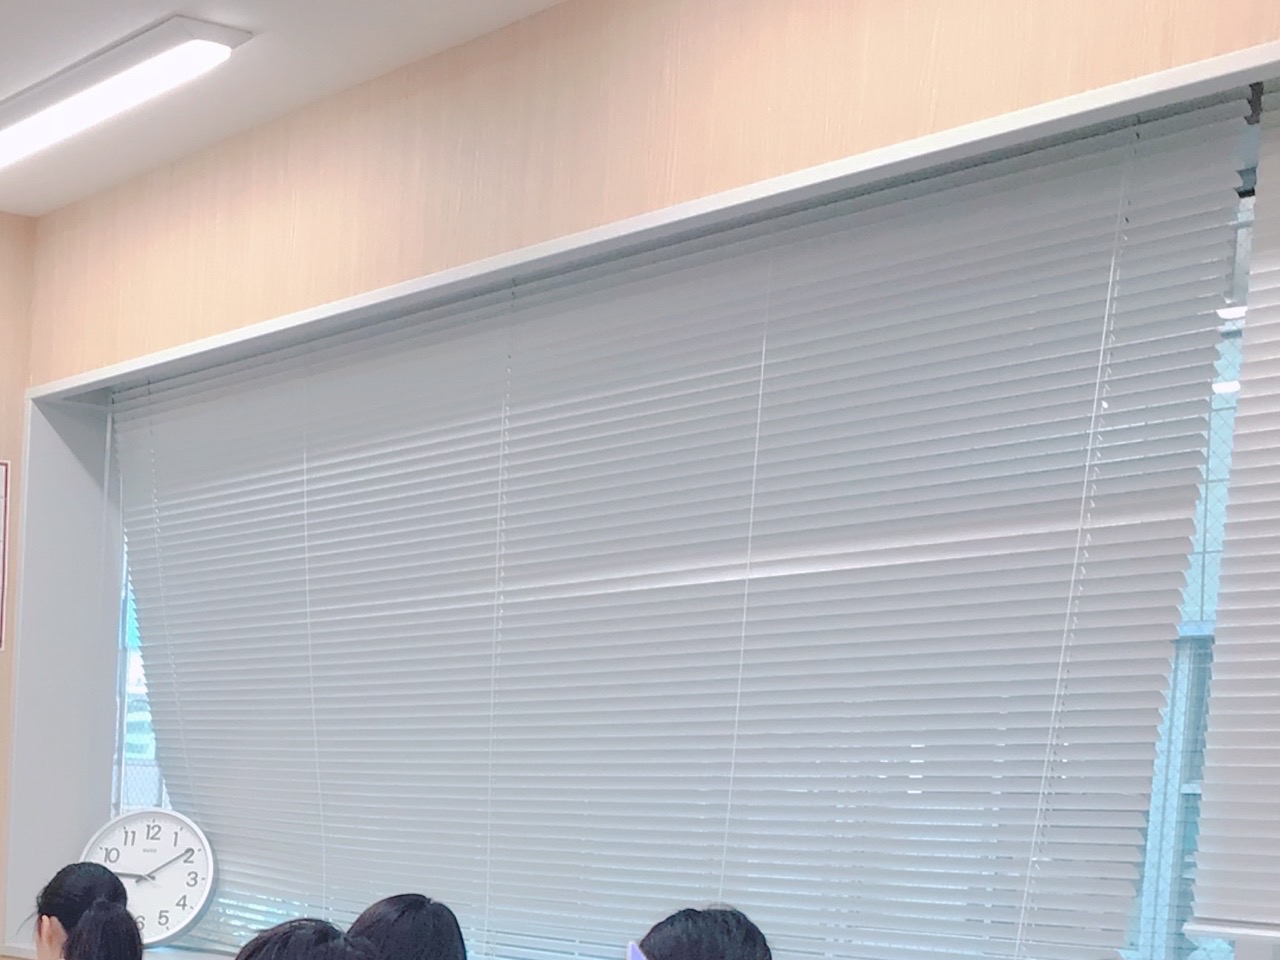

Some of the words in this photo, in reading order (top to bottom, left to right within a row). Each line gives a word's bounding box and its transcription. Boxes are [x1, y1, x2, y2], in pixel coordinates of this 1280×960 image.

[123, 830, 137, 847] 11
[145, 824, 162, 841] 12
[173, 831, 179, 847] 1
[103, 847, 121, 864] 10
[182, 847, 196, 864] 2
[185, 871, 199, 888] 3
[175, 894, 188, 911] 4
[157, 910, 170, 927] 5
